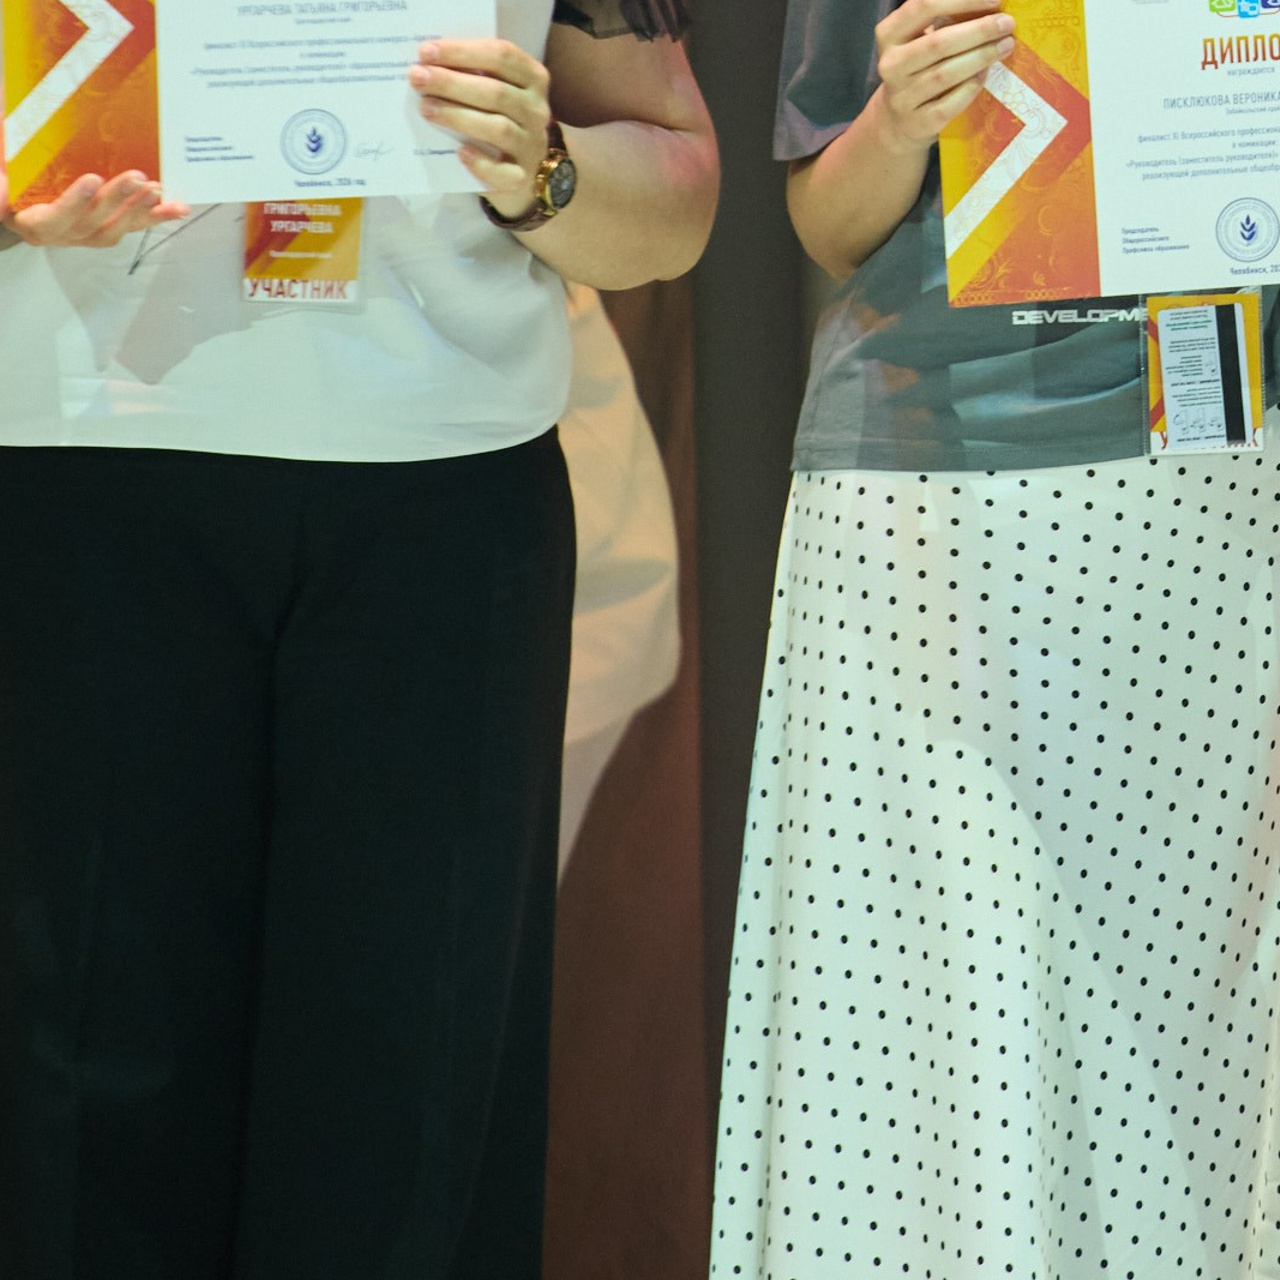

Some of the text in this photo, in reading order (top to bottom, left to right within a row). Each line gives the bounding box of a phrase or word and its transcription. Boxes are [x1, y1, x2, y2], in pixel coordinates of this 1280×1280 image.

[1227, 66, 1275, 76] награждается
[1163, 94, 1229, 109] ПИСКЛЮКОВА
[1138, 133, 1170, 143] финалист
[1181, 127, 1235, 139] Всероссийского
[1142, 169, 1188, 181] реализующей
[1191, 165, 1247, 177] дополнительные
[1229, 265, 1268, 275] Челябинск,
[249, 278, 348, 299] УЧАСТНИК
